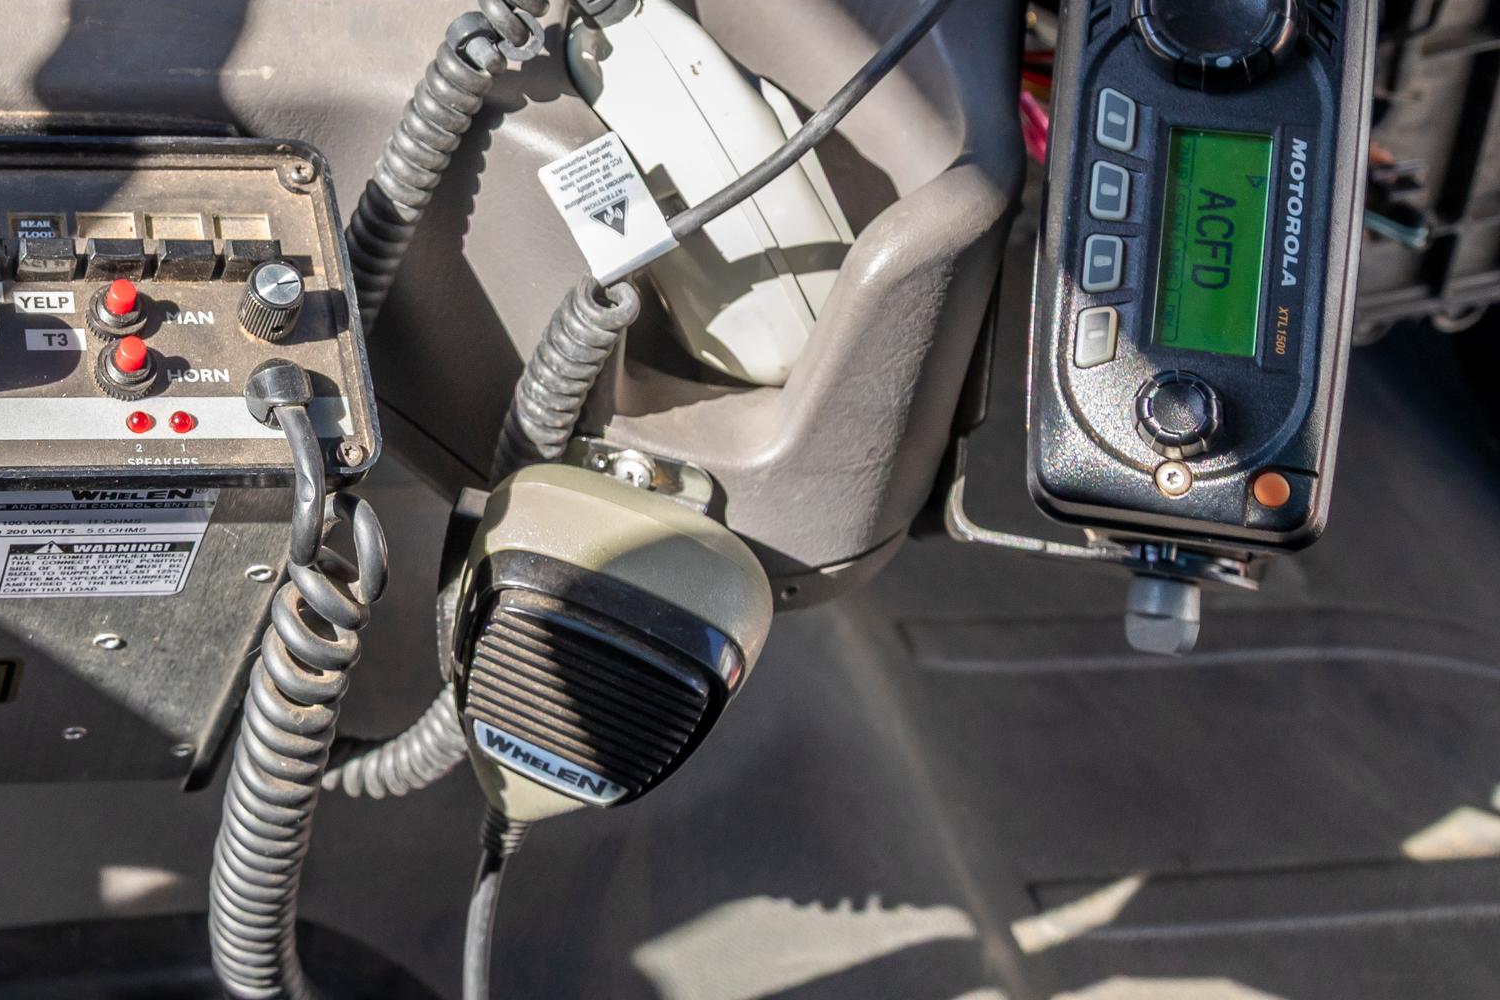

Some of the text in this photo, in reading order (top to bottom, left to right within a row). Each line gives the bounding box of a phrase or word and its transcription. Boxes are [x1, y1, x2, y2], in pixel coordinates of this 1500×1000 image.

[610, 157, 622, 167] FCC
[1281, 137, 1308, 287] MOTOROLA
[20, 220, 50, 228] REAR
[18, 231, 56, 239] FLOOD
[1190, 187, 1237, 290] ACFD
[18, 296, 69, 309] YELP
[166, 311, 214, 325] MAN
[42, 333, 69, 347] T3
[166, 368, 230, 383] HORN
[135, 443, 186, 453] 2 1
[127, 457, 199, 466] SPEAKERS
[71, 488, 195, 501] WHELEN
[11, 503, 38, 511] AND
[73, 542, 171, 553] WARNING!
[485, 728, 608, 797] WHELEN
